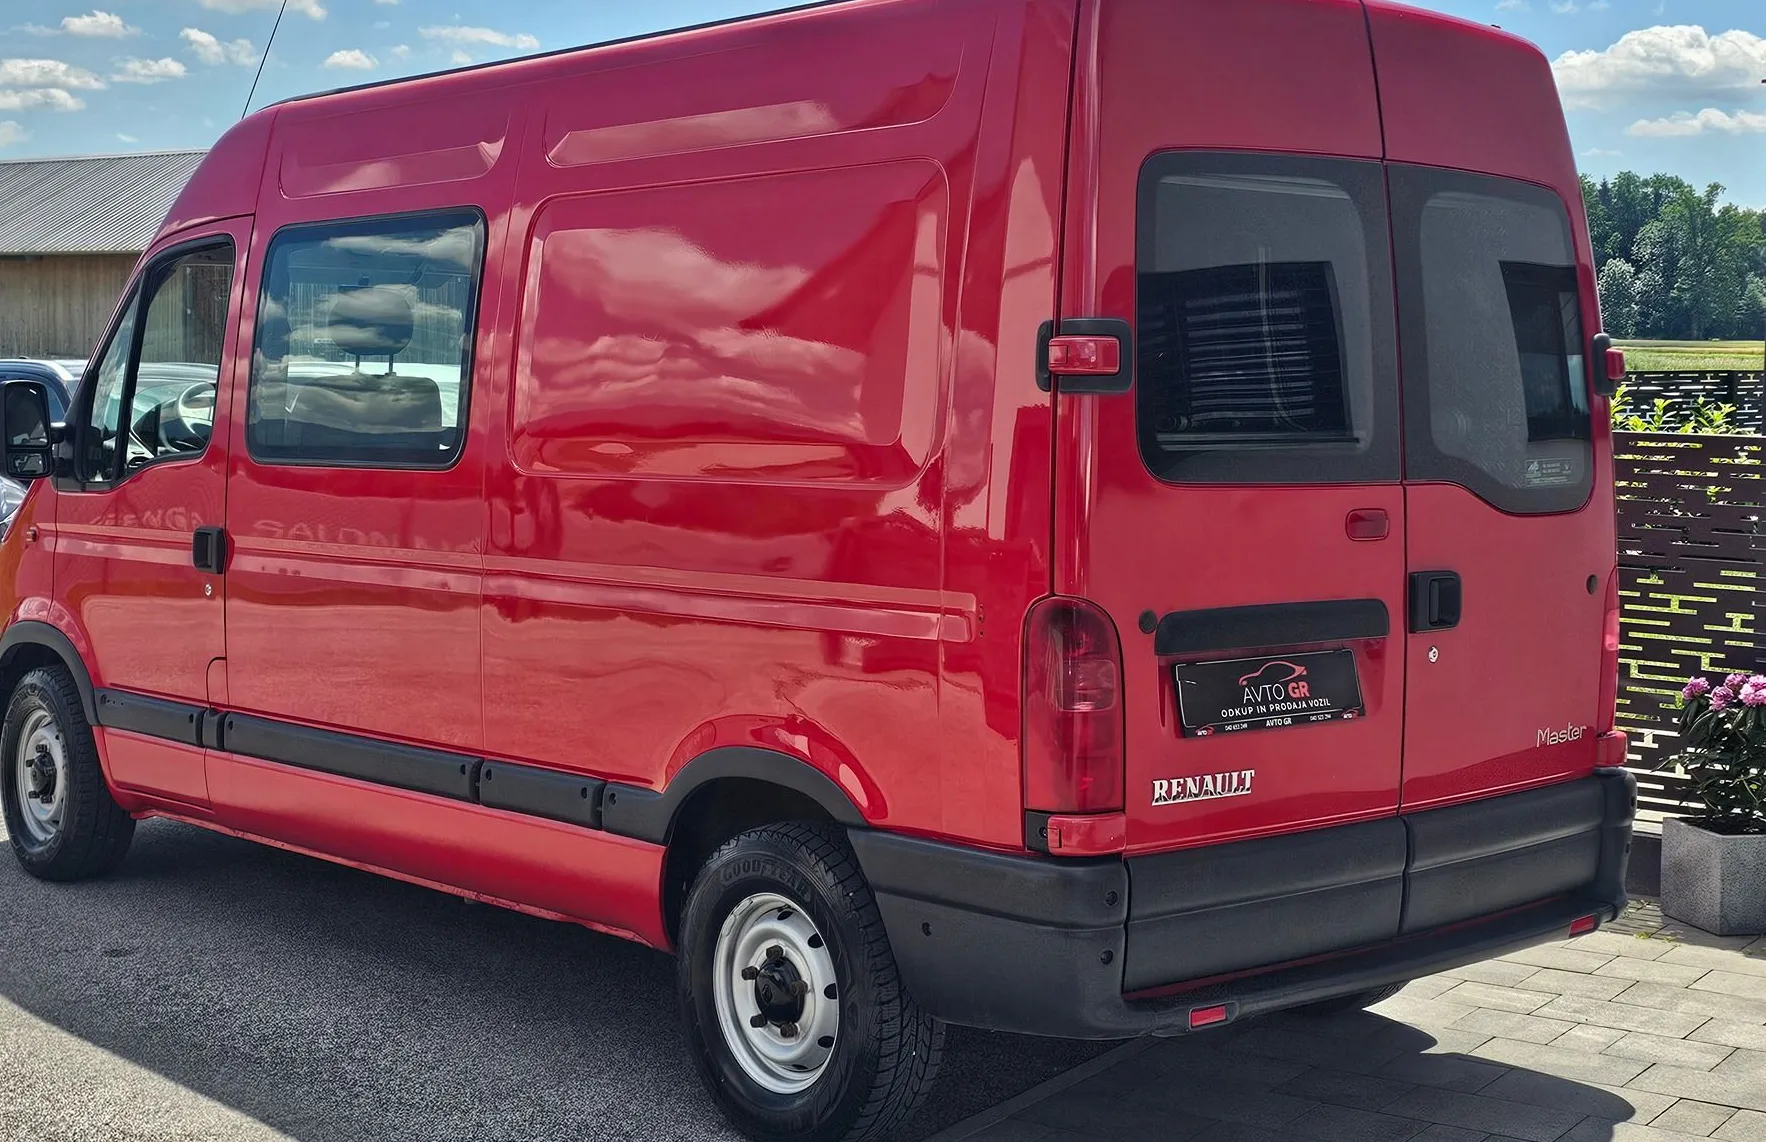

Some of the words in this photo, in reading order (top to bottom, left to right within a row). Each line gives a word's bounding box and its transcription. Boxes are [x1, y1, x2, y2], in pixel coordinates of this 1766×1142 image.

[1243, 683, 1285, 704] AVTO
[1287, 681, 1311, 698] GR
[1221, 706, 1254, 718] ODKUP
[1256, 705, 1267, 714] IN
[1269, 700, 1308, 712] PRODAJA
[1308, 698, 1331, 708] VOZIL
[1265, 718, 1283, 727] AVTO
[1283, 717, 1292, 725] GR
[1536, 721, 1587, 748] Master
[1151, 769, 1255, 806] RENAULT
